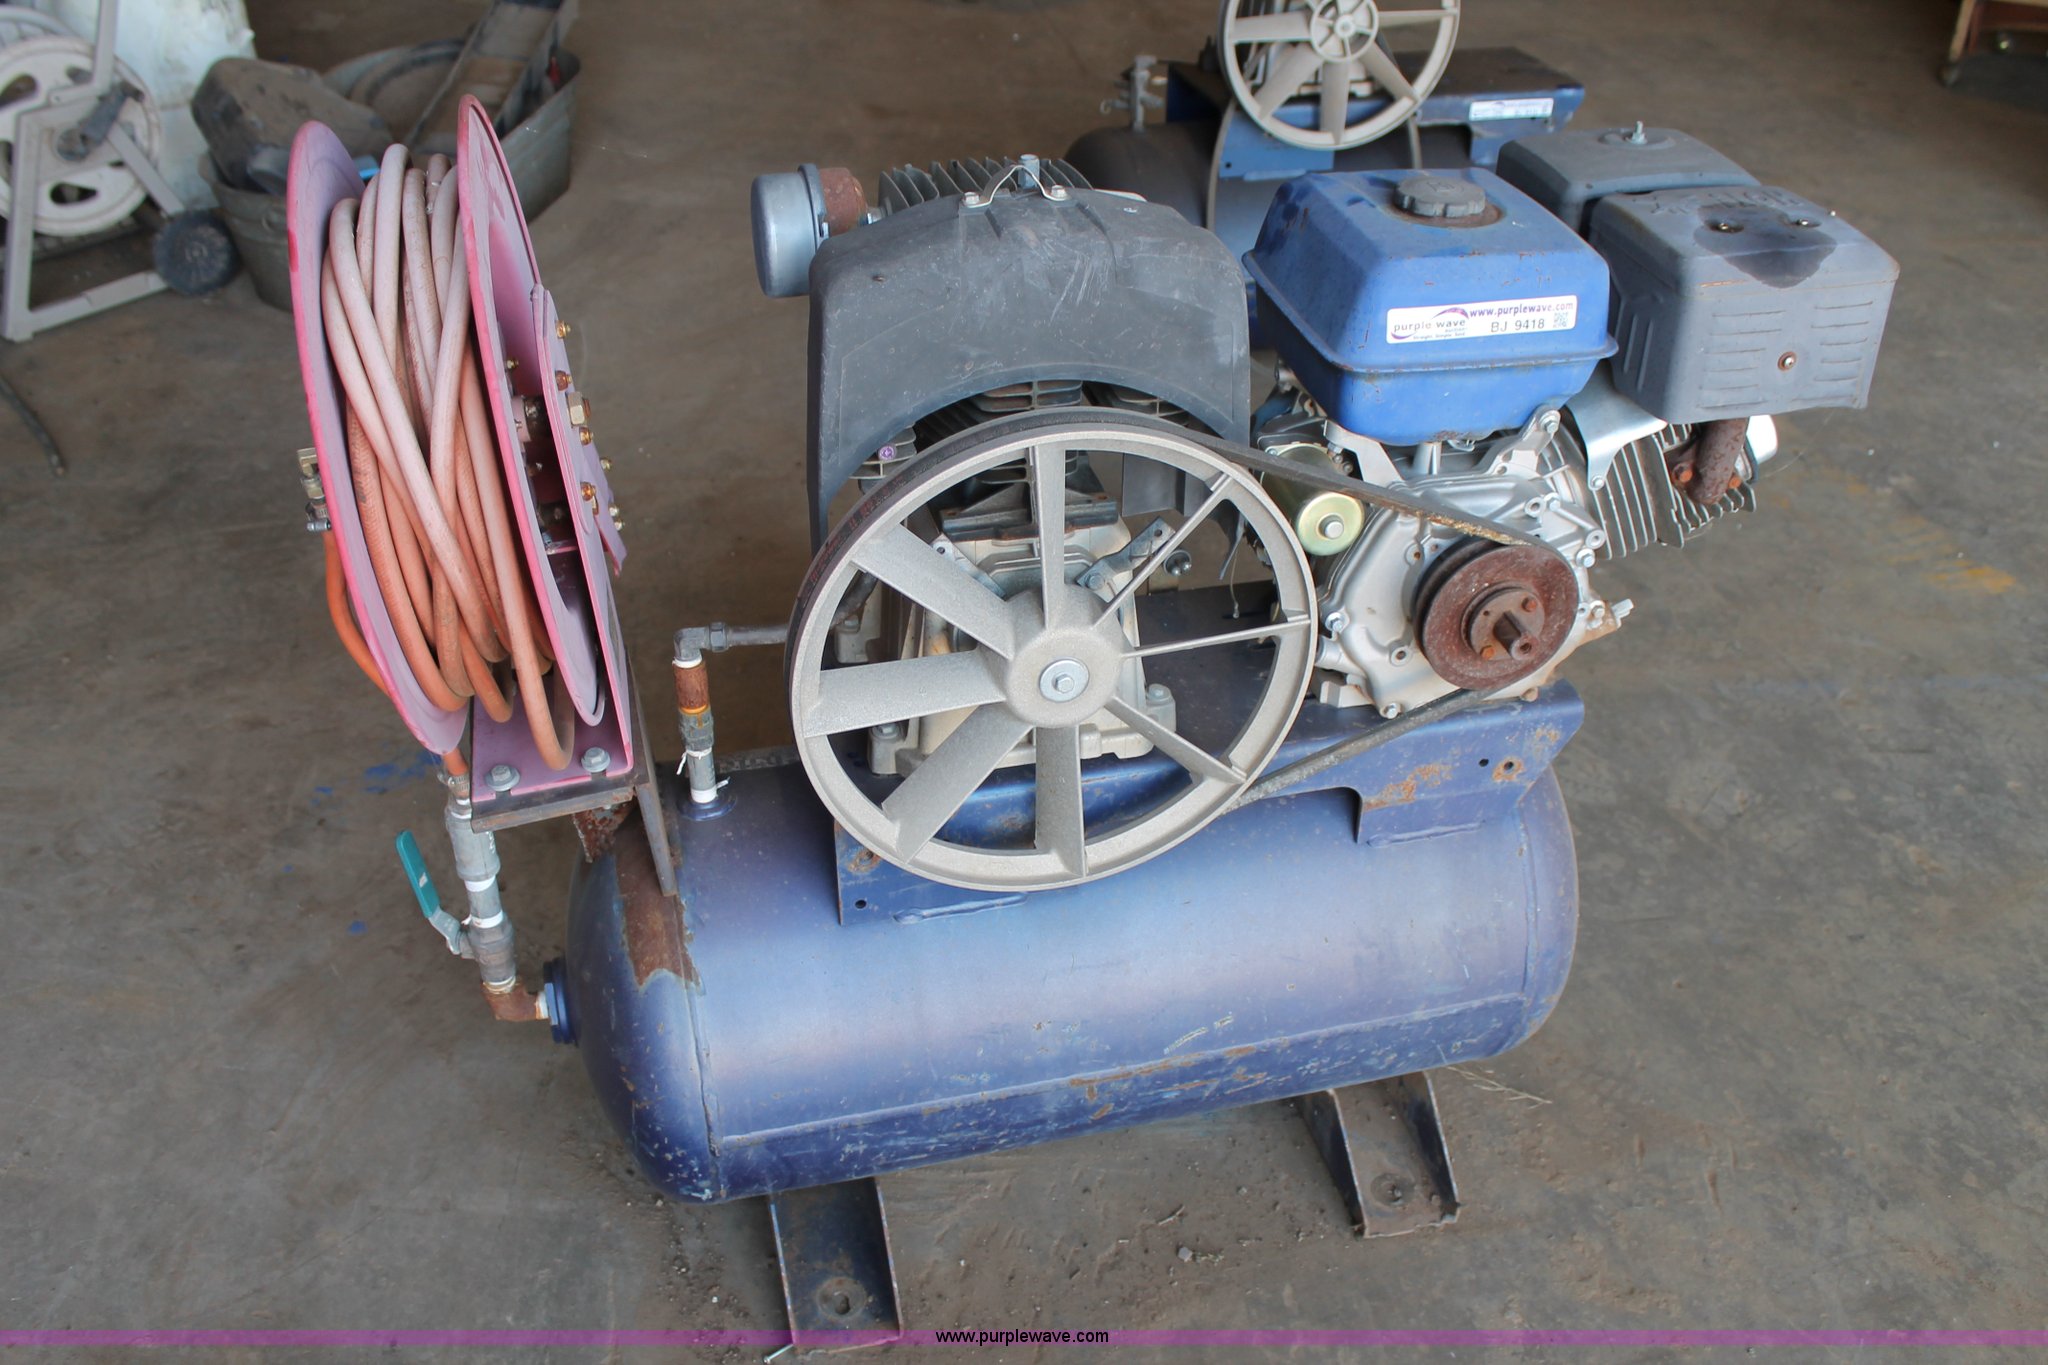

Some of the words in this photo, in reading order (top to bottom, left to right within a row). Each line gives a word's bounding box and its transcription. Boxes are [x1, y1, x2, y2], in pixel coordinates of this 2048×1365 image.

[1469, 302, 1573, 317] www.purplewave.com
[1394, 321, 1432, 333] purple
[1436, 319, 1466, 328] wave
[1490, 321, 1508, 333] BJ
[1515, 318, 1545, 331] 9418
